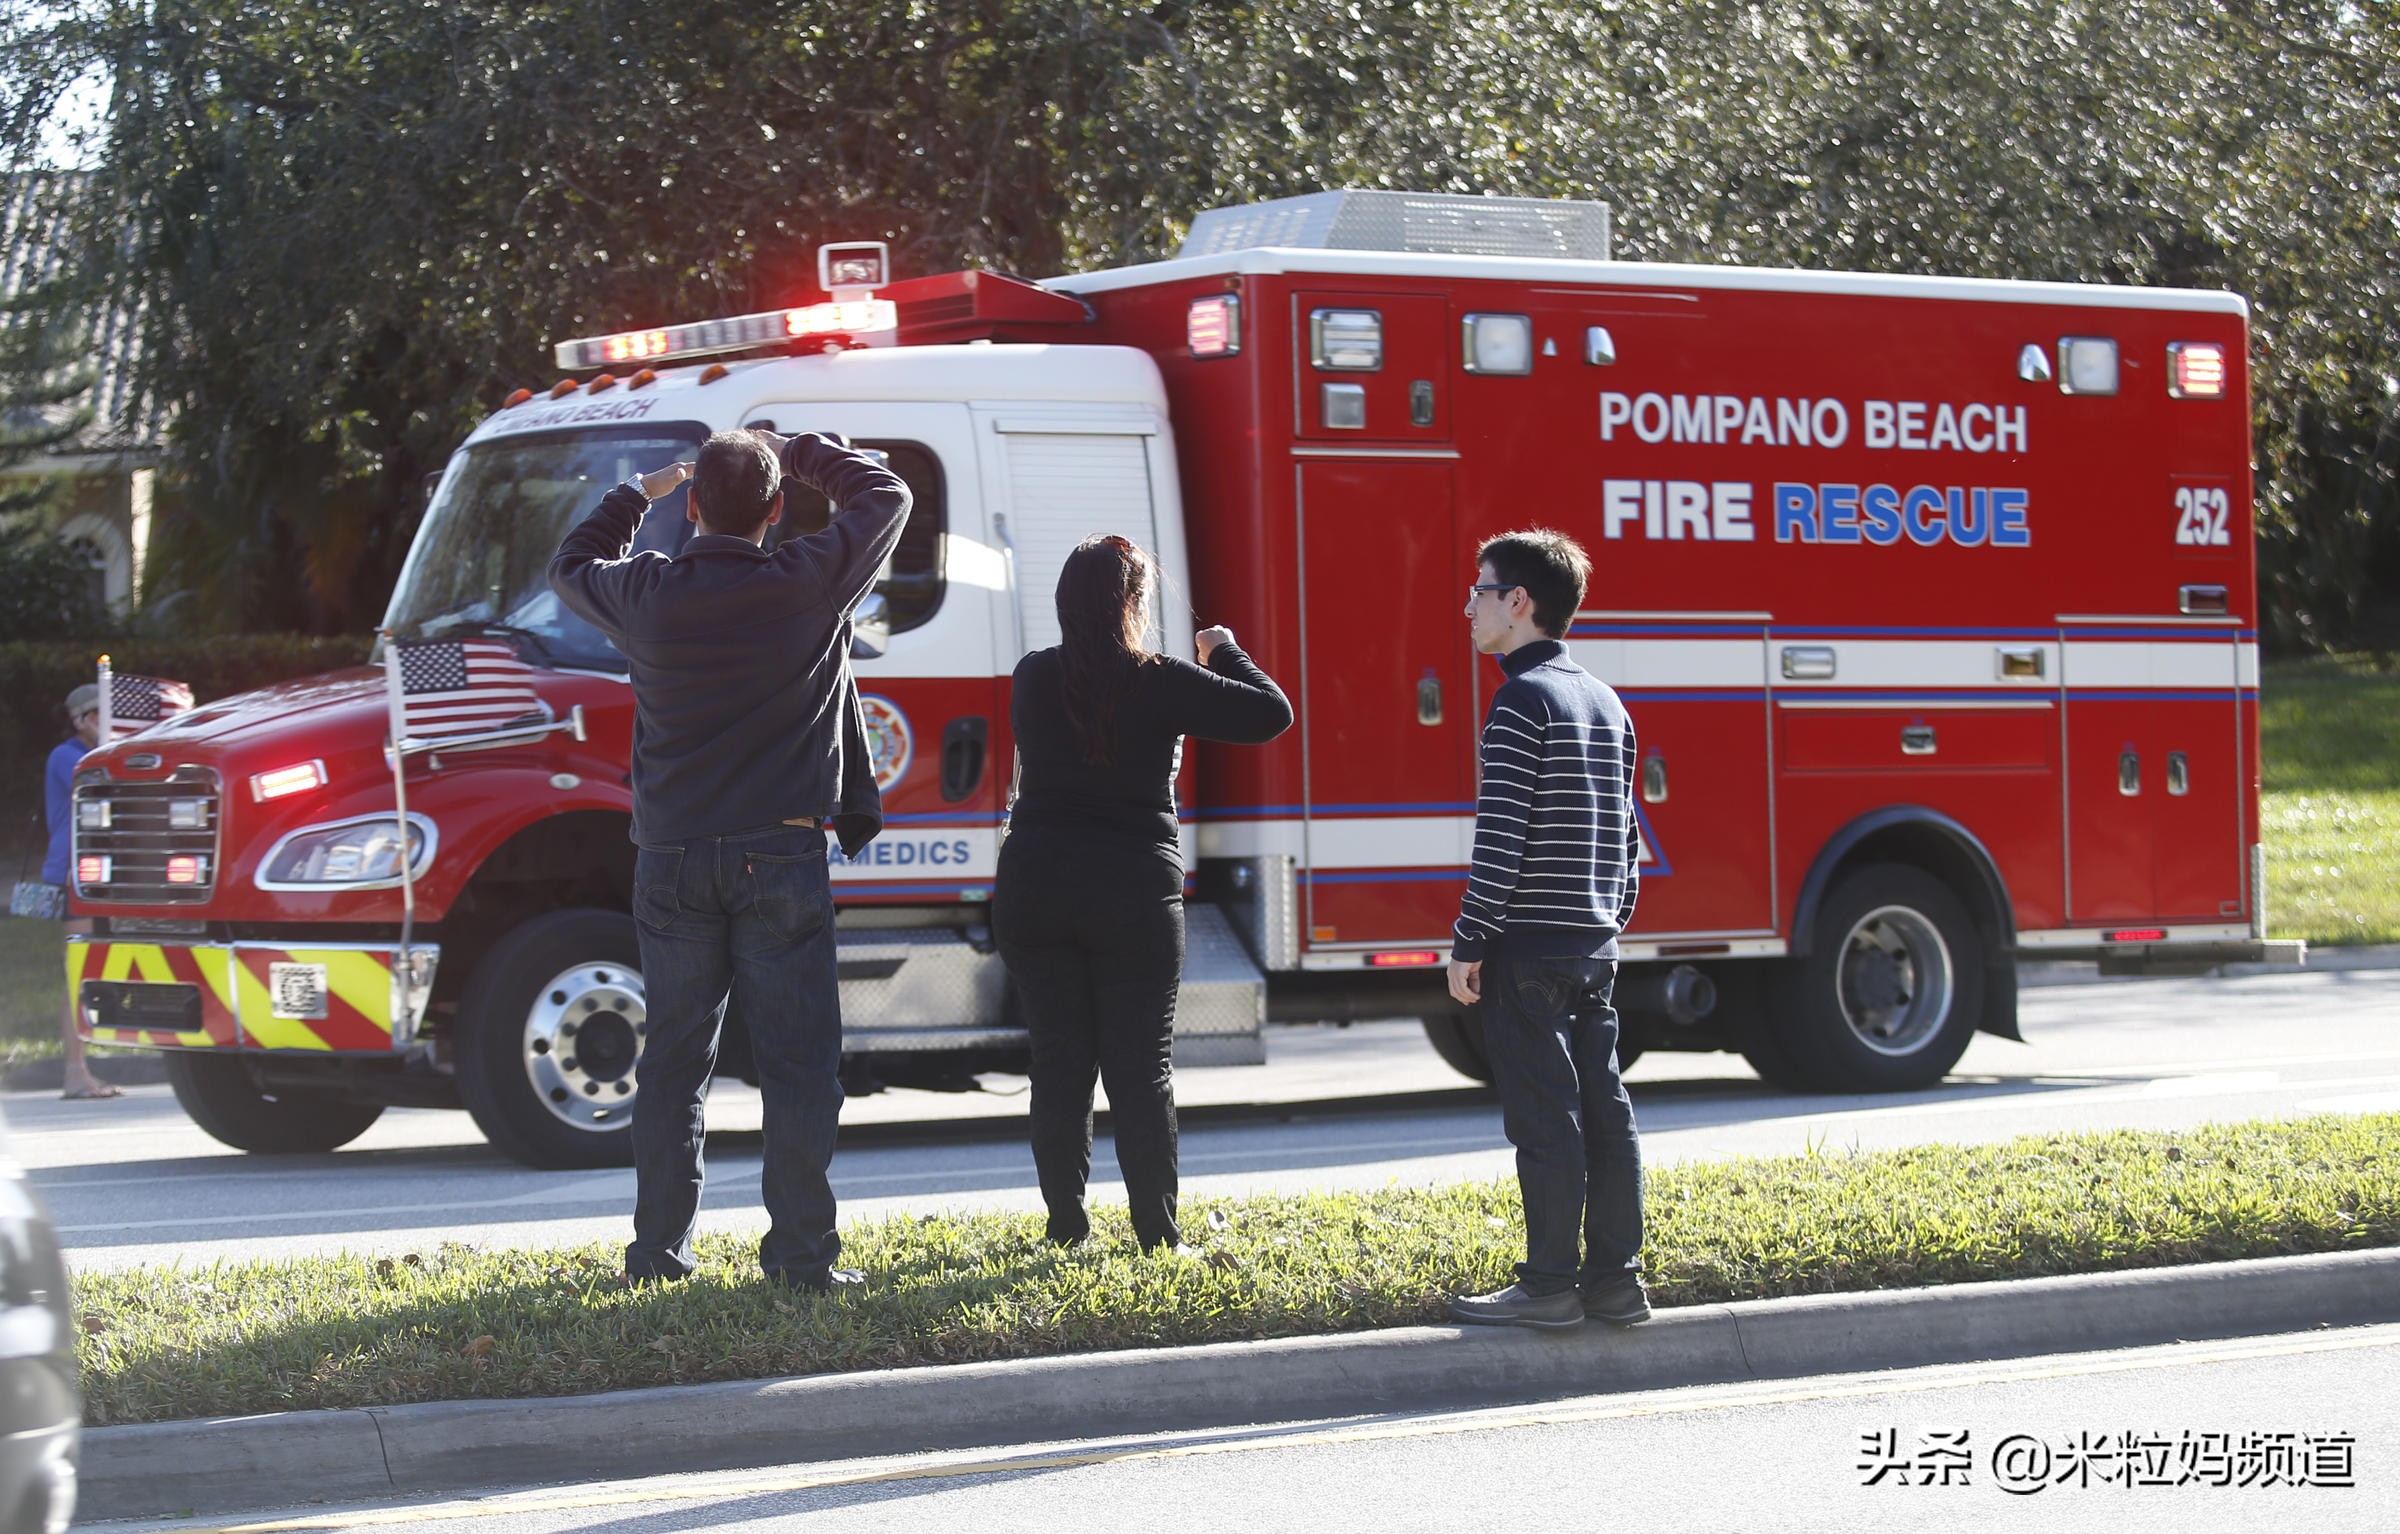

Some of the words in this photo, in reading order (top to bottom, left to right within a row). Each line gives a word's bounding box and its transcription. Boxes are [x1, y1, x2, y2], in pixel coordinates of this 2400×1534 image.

[572, 399, 659, 422] BEACH
[1599, 391, 1849, 449] POMPANO
[1864, 400, 2027, 453] BEACH
[1602, 479, 1755, 542] FIRE
[1773, 481, 2031, 548] RESCUE
[2174, 486, 2230, 546] 252
[828, 840, 970, 866] AMEDICS
